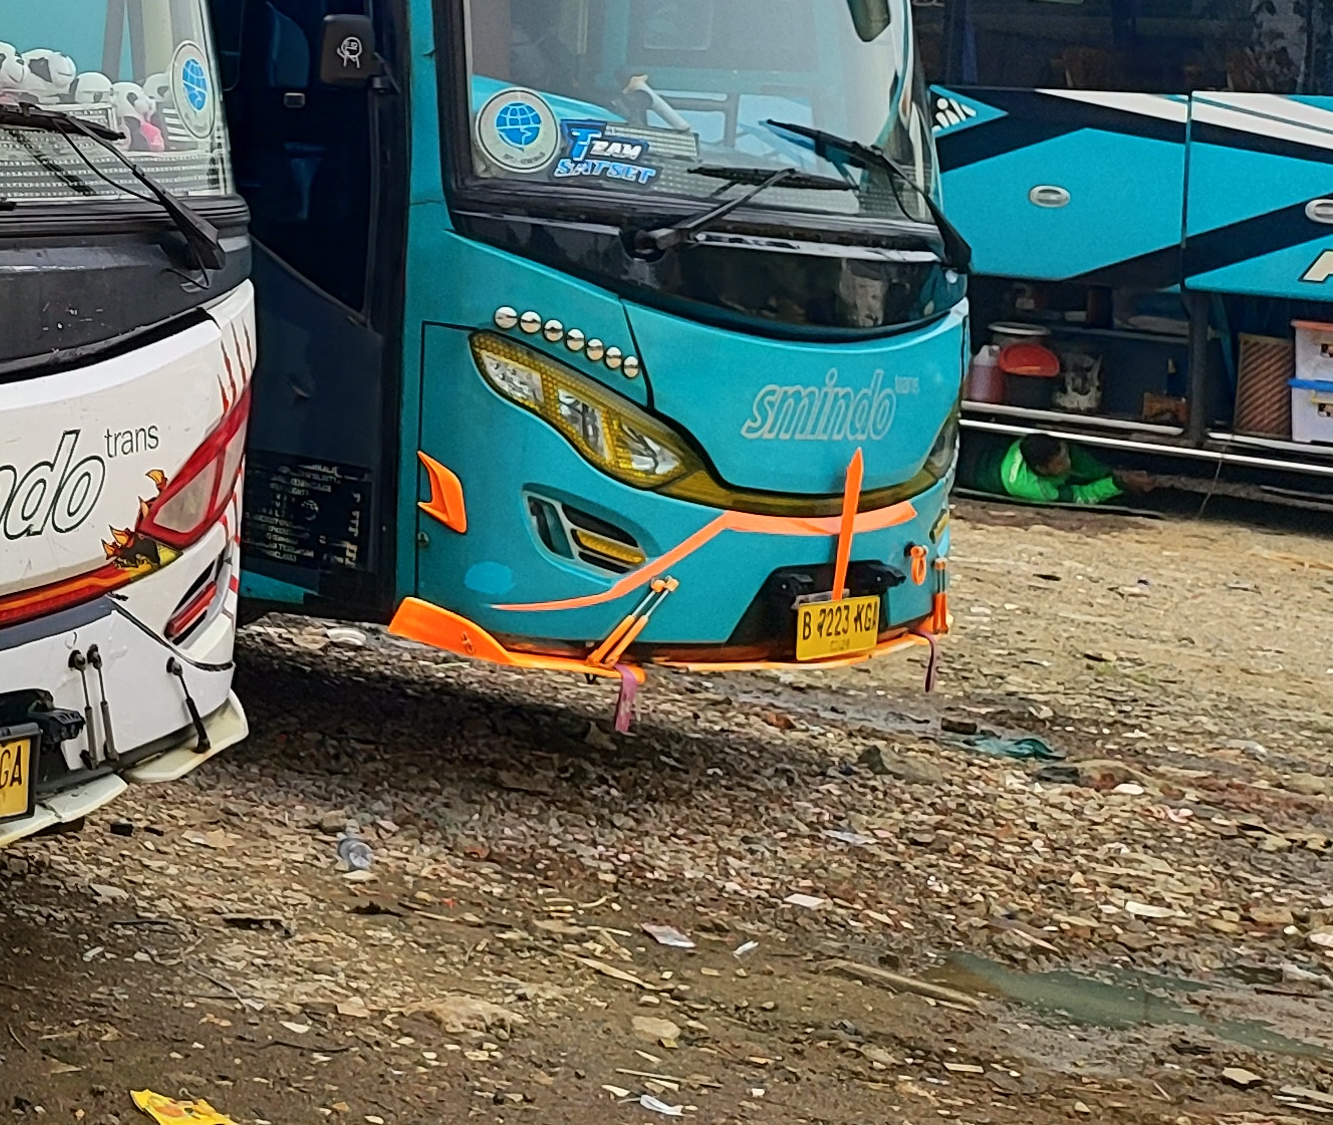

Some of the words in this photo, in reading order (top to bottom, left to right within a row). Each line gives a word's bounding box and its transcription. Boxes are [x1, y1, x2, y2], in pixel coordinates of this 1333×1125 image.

[740, 367, 897, 442] smindo
[104, 424, 161, 458] trans
[802, 610, 812, 641] B
[816, 604, 851, 639] 7223
